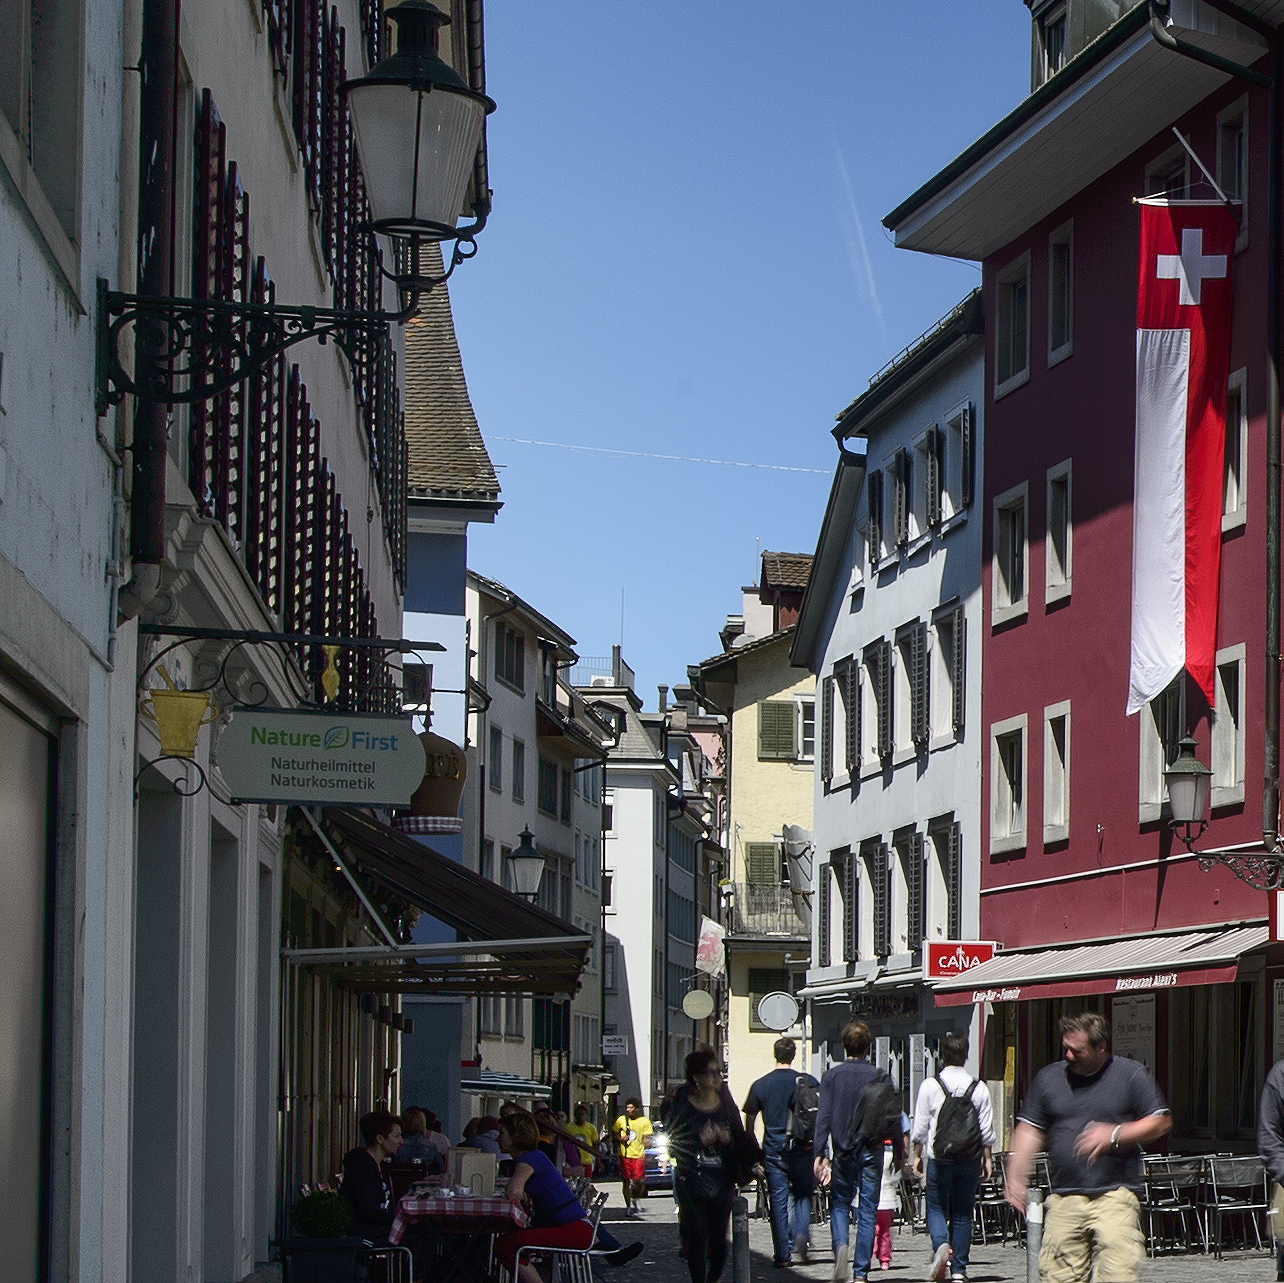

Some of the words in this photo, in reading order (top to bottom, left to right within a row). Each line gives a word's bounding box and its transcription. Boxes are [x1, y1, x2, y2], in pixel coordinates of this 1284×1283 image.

[250, 726, 321, 747] Nature
[352, 731, 399, 751] First
[271, 756, 376, 774] Naturheilmittel
[270, 773, 375, 790] Naturkosmetik
[938, 952, 981, 970] CANA
